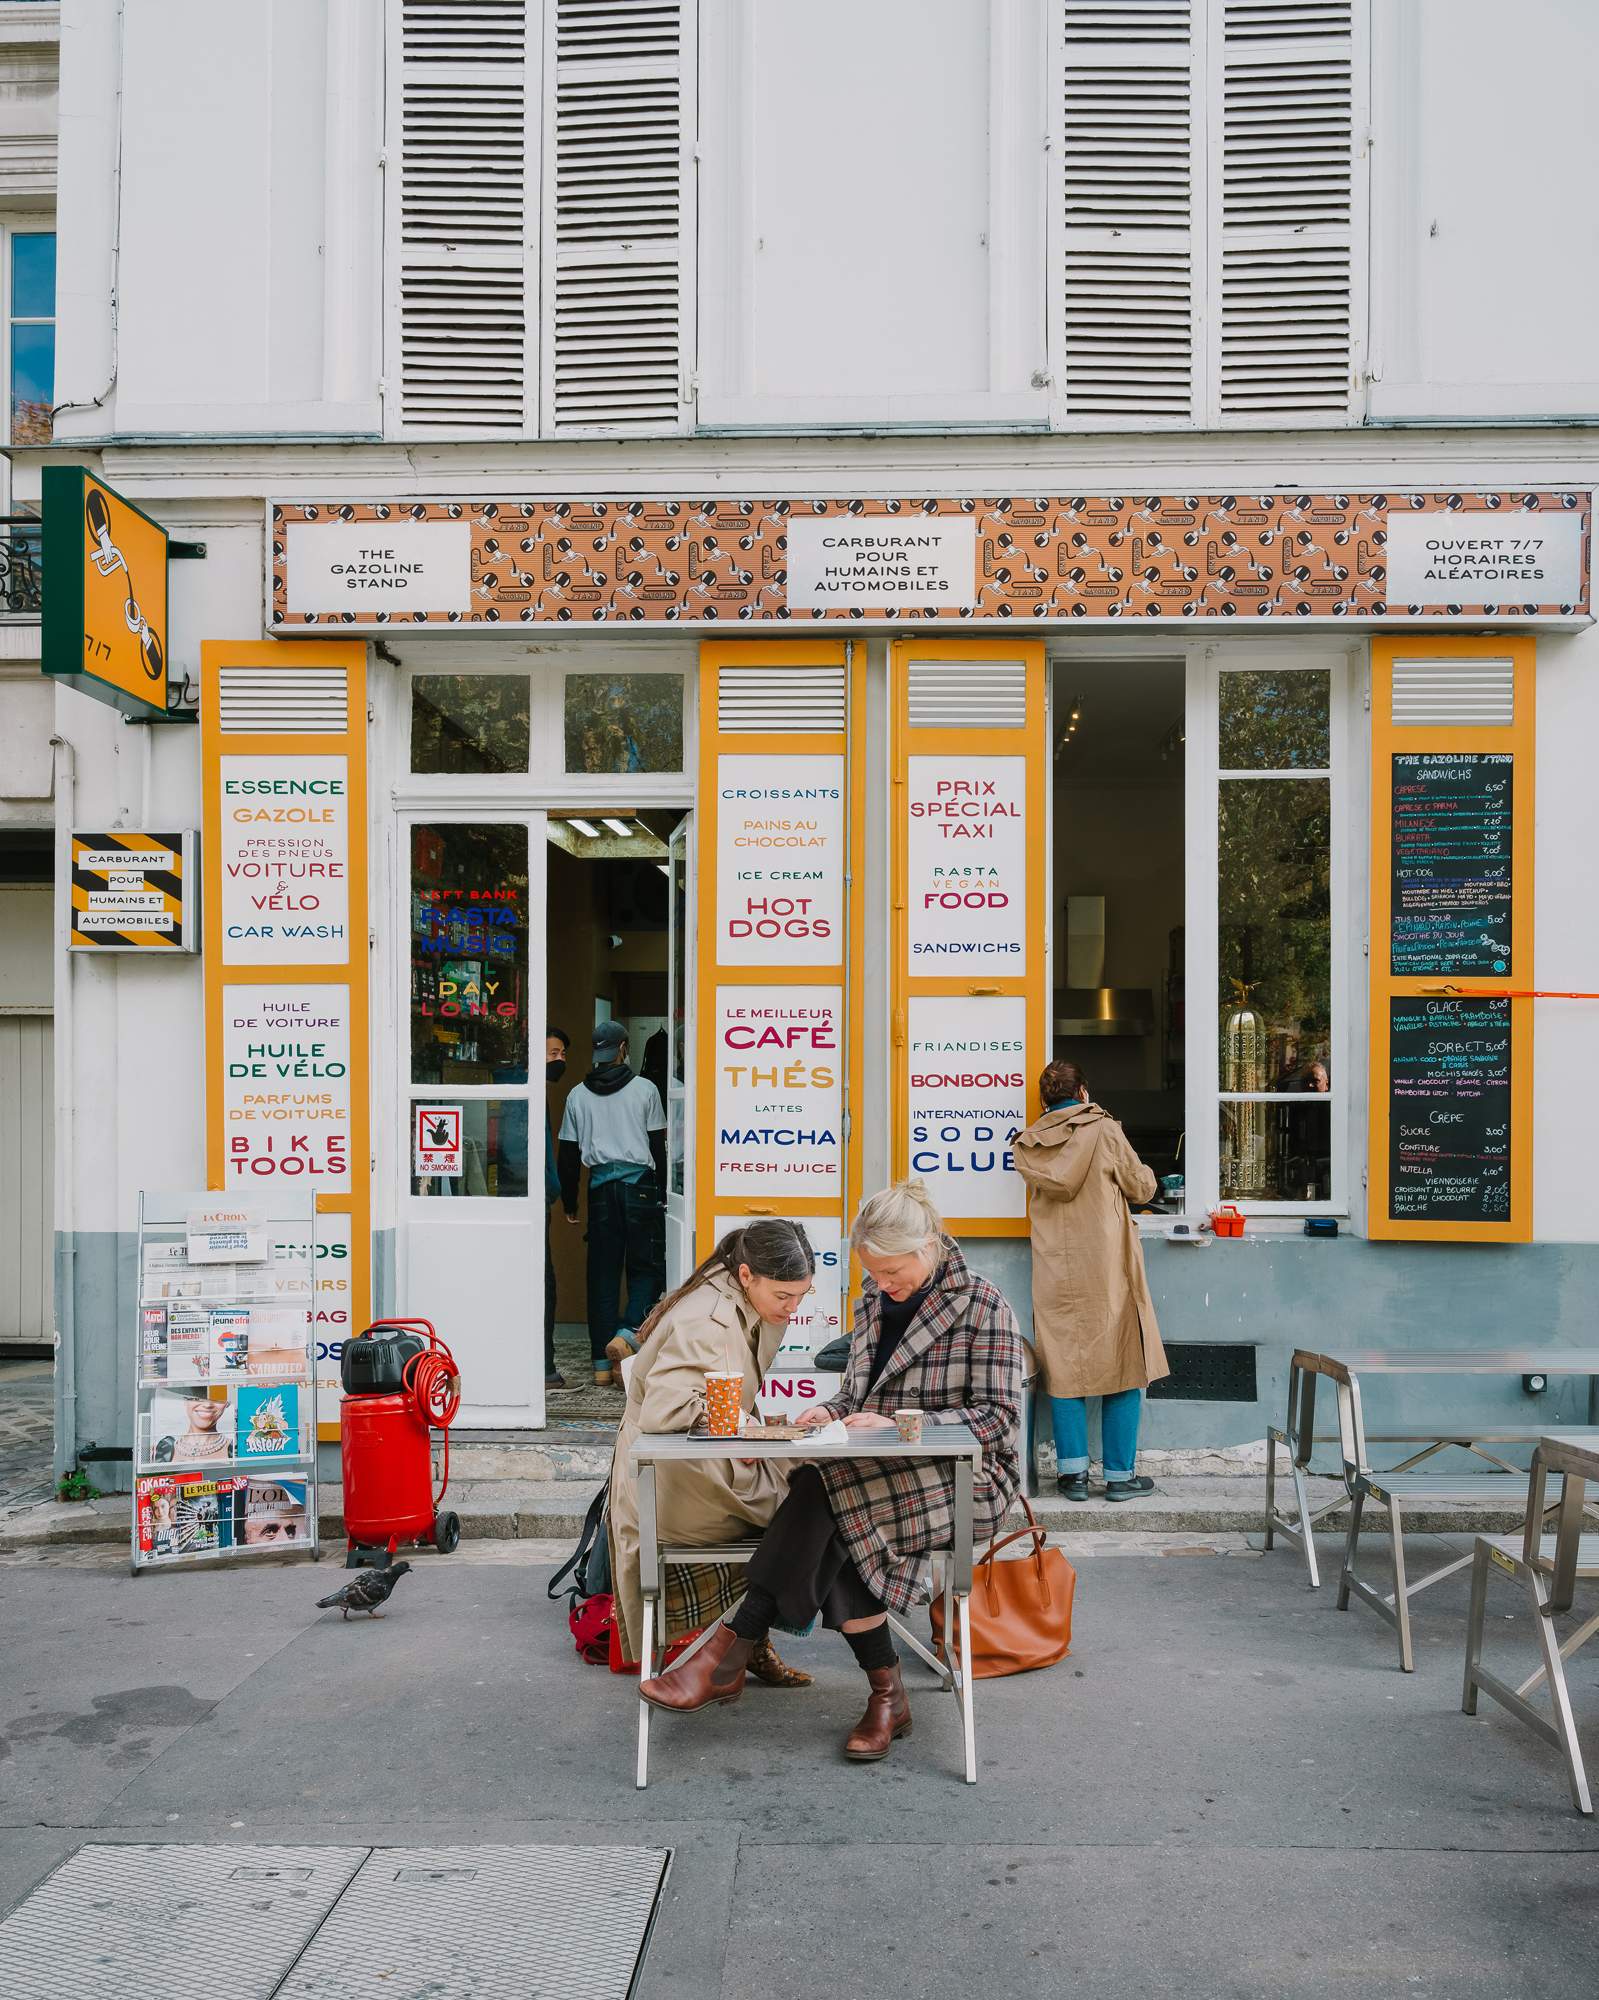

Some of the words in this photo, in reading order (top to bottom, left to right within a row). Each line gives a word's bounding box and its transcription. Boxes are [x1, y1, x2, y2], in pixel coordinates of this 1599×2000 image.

[823, 537, 942, 547] CARBURANT
[1426, 540, 1504, 550] OUVERT
[1510, 540, 1543, 550] 7/7
[359, 550, 395, 559] THE
[856, 552, 908, 561] POUR
[1434, 555, 1535, 565] HORAIRES
[331, 564, 423, 574] GAZOLINE
[826, 567, 910, 576] HUMAINS
[917, 567, 938, 575] ET
[1424, 564, 1544, 579] ALÉATOIRES
[347, 579, 407, 588] STAND
[815, 581, 948, 591] AUTOMOBILES
[85, 634, 111, 661] 7/7
[1395, 755, 1419, 764] THE
[1423, 755, 1478, 764] GAZOLINE
[1481, 754, 1513, 764] STAND
[1417, 769, 1472, 780] SANDWICHS
[226, 781, 344, 794] ESSENCE
[937, 781, 995, 795] PRIX
[723, 789, 839, 799] CROISSANTS
[910, 798, 1021, 817] SPÉCIAL
[233, 808, 335, 823] GAZOLE
[744, 821, 791, 830] PAINS
[794, 821, 817, 830] AU
[938, 824, 992, 838] TAXI
[247, 839, 323, 847] PRESSION
[735, 837, 827, 847] CHOCOLAT
[239, 848, 272, 858] DES
[278, 848, 334, 858] PNEUS
[227, 863, 343, 877] VOITURE
[935, 867, 997, 876] RASTA
[1396, 869, 1433, 878] HOT-DOG
[109, 876, 144, 884] POUR
[738, 872, 762, 880] ICE
[770, 871, 822, 880] CREAM
[275, 881, 288, 895] &
[933, 880, 999, 889] VEGAN
[90, 896, 145, 905] HUMAINS
[149, 896, 162, 904] ET
[251, 889, 319, 910] VÉLO
[421, 891, 464, 901] LEFT
[470, 891, 519, 900] BANK
[925, 893, 1008, 909] FOOD
[748, 898, 812, 916] HOT
[421, 906, 518, 925] RASTA
[1429, 914, 1451, 922] JOUR
[228, 926, 273, 938] CAR
[282, 925, 343, 938] WASH
[729, 919, 830, 938] DOGS
[421, 935, 518, 953] MUSIC
[914, 943, 1020, 953] SANDWICHS
[439, 981, 500, 995] DAY
[264, 1003, 310, 1012] HUILE
[421, 1002, 516, 1017] LONG
[1427, 1001, 1463, 1014] GLACE
[727, 1009, 746, 1018] LE
[751, 1009, 832, 1018] MEILLEUR
[234, 1019, 257, 1027] DE
[266, 1019, 339, 1027] VOITURE
[724, 1020, 836, 1049] CAFÉ
[914, 1042, 1022, 1051] FRIANDISES
[1428, 1041, 1485, 1054] SORBET
[248, 1044, 325, 1060] HUILE
[230, 1064, 267, 1077] DE
[277, 1059, 345, 1077] VÉLO
[724, 1060, 834, 1088] THÉS
[911, 1073, 1024, 1087] BONBONS
[244, 1094, 332, 1104] PARFUMS
[230, 1110, 256, 1120] DE
[262, 1109, 346, 1120] VOITURE
[914, 1110, 1023, 1119] INTERNATIONAL
[1430, 1111, 1464, 1124] CRÊPE
[913, 1126, 1022, 1142] SODA
[1400, 1125, 1431, 1136] SUCRE
[721, 1129, 836, 1145] MATCHA
[232, 1136, 345, 1152] BIKE
[1399, 1142, 1440, 1153] CONFITURE
[423, 1154, 455, 1163] 禁煙
[230, 1156, 346, 1175] TOOLS
[720, 1163, 777, 1172] FRESH
[784, 1164, 836, 1173] JUICE
[1400, 1165, 1432, 1174] NUTELLA
[1425, 1177, 1480, 1185] VIENNOISERIE
[1432, 1194, 1470, 1202] CHOCOLAT
[1394, 1203, 1428, 1214] BRIOCHE
[213, 1317, 234, 1325] jeune
